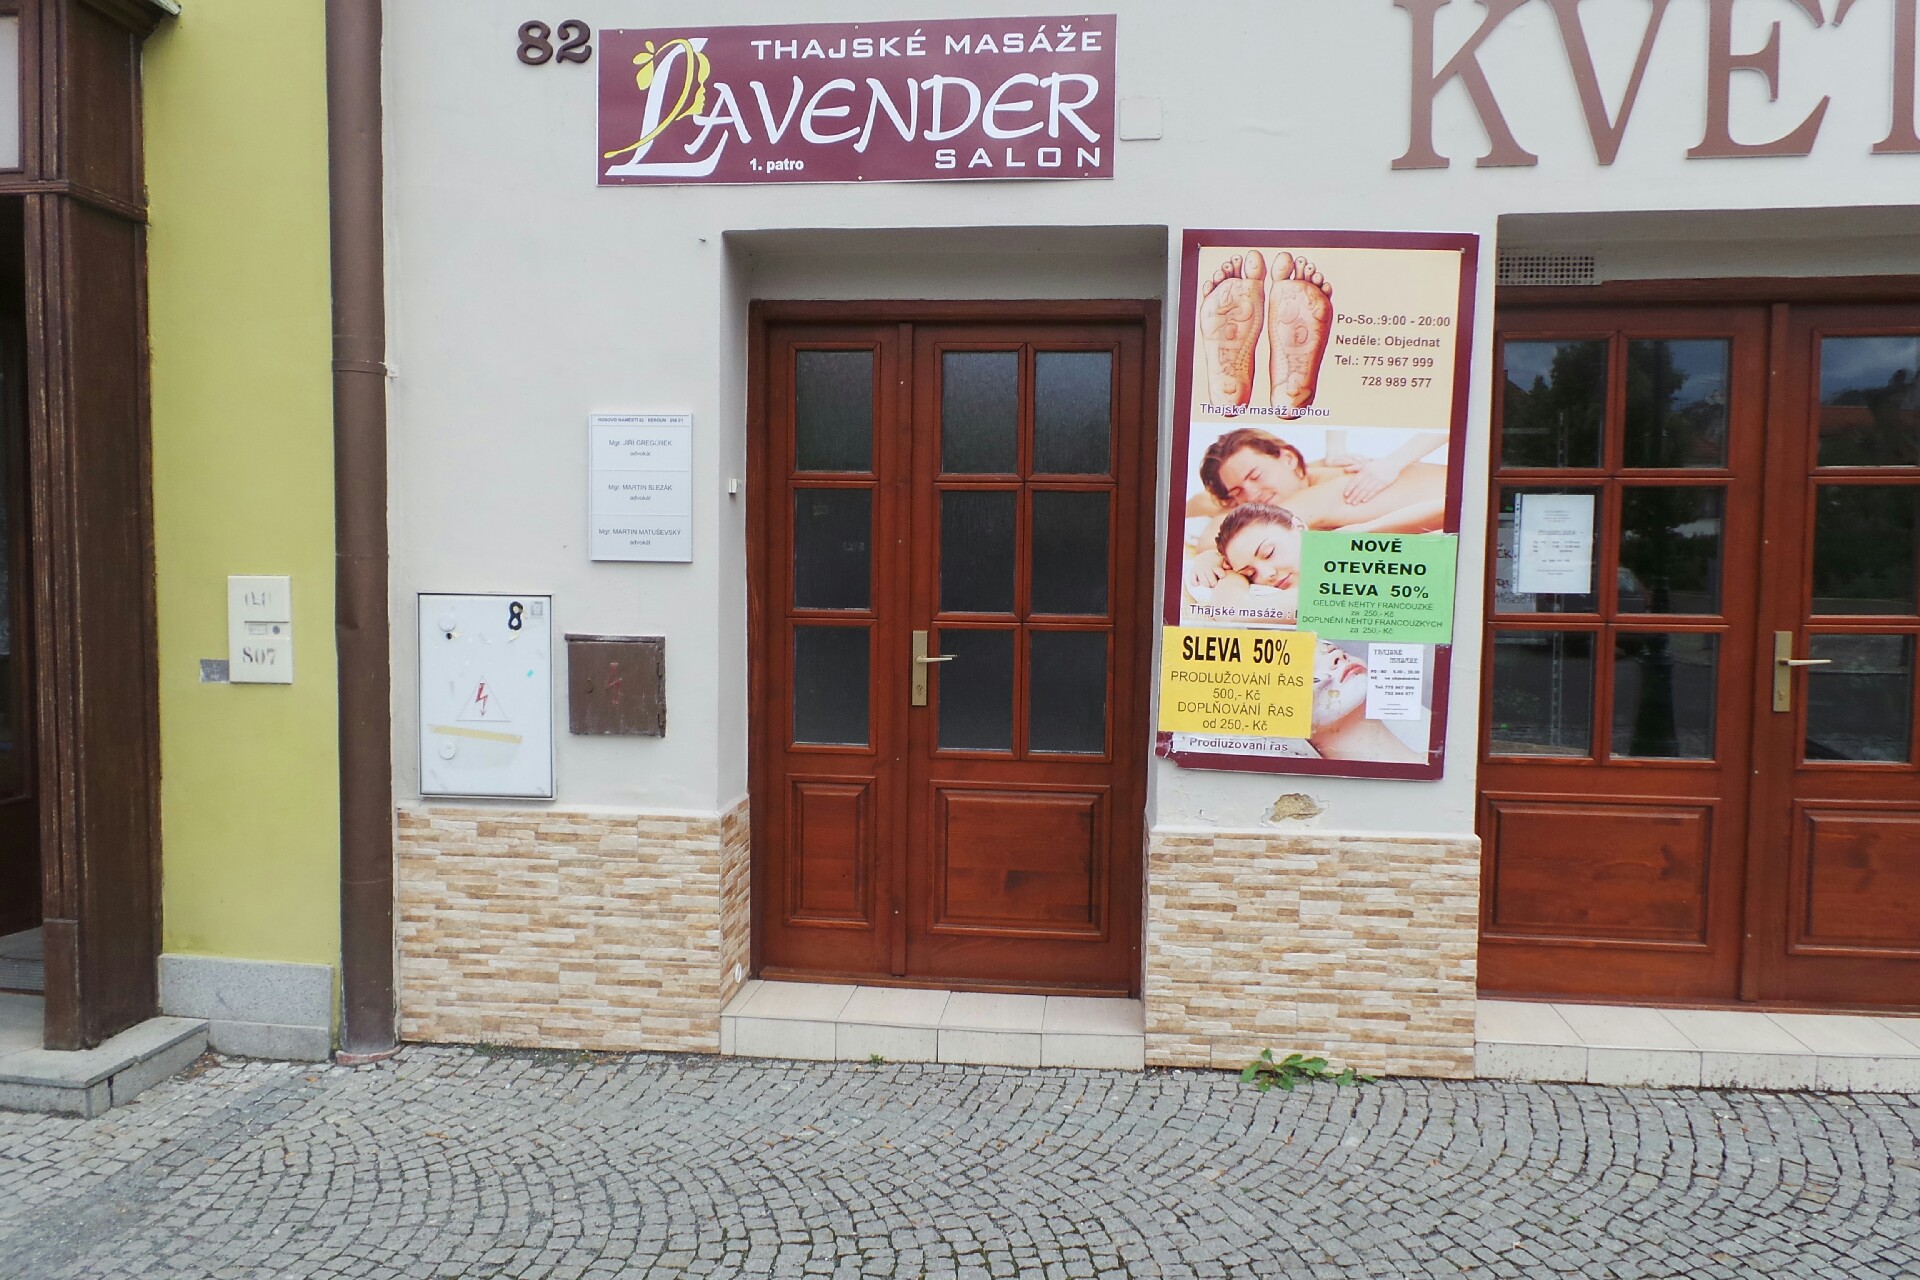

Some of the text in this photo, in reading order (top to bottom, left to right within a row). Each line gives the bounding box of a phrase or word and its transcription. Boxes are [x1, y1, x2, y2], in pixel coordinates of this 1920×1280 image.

[516, 19, 593, 66] 82
[751, 28, 1102, 61] THAJSKÉ MASÁŽE
[605, 37, 1101, 177] LAVENDER
[750, 158, 804, 174] 1. patro
[934, 147, 1101, 170] SALON
[1418, 316, 1451, 327] 20:00
[1336, 335, 1441, 349] Neděle: Objednat
[1335, 355, 1434, 368] Tel.: 775 967 999
[1362, 376, 1432, 388] 728 989 577
[1200, 403, 1330, 417] Thajská masáž nohou
[1351, 538, 1402, 553] NOVĚ
[1324, 560, 1427, 576] OTEVŘENO
[1319, 583, 1429, 599] SLEVA 50%
[1190, 604, 1235, 618] Thajské
[1239, 607, 1283, 619] masáže
[1349, 601, 1376, 609] NEHTY
[508, 601, 524, 630] 8
[1384, 610, 1394, 618] Kč
[1383, 627, 1393, 635] Kč
[1182, 635, 1290, 666] SLEVA 50%
[1170, 670, 1304, 687] PRODLUŽOVÁNÍ ŘAS
[1246, 690, 1261, 701] Kč
[1177, 701, 1294, 718] DOPLŇOVÁNÍ ŘAS
[1202, 719, 1216, 729] od
[1253, 720, 1268, 731] Kč
